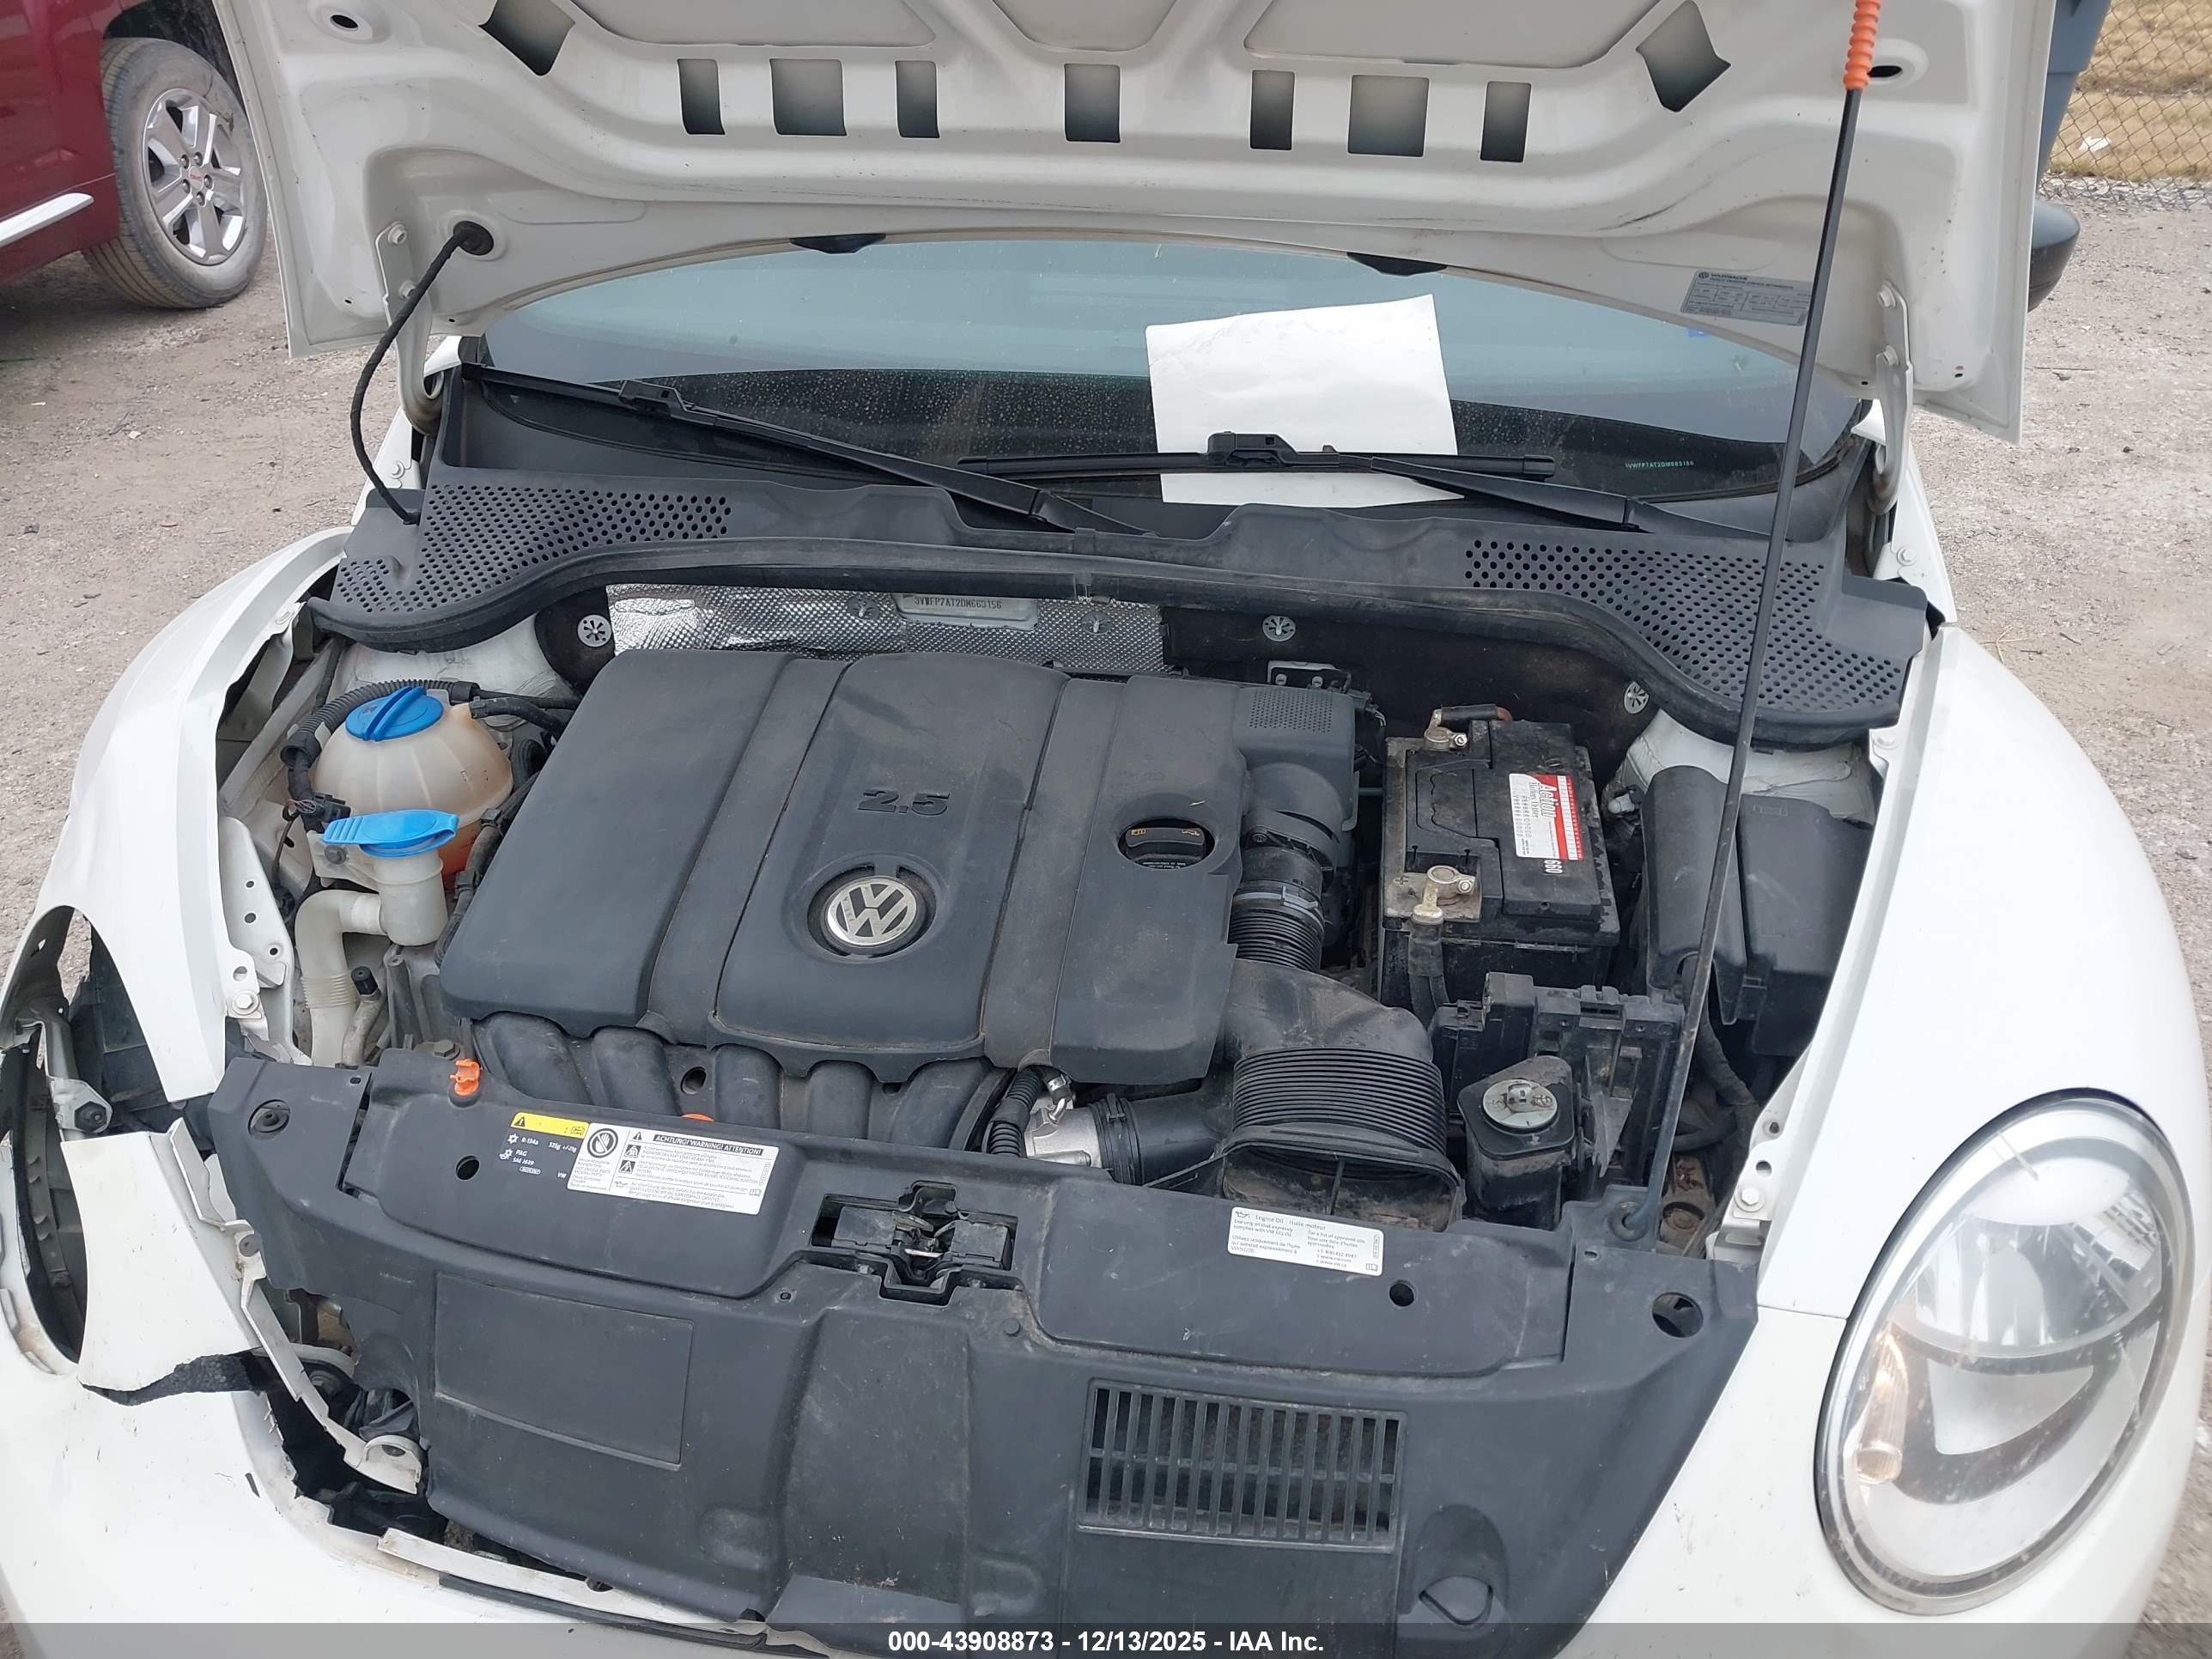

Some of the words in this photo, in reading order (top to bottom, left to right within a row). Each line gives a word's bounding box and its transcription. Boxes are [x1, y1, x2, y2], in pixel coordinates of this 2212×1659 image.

[857, 788, 951, 816] 2.5
[1539, 782, 1559, 818] Action
[1544, 860, 1563, 874] 660
[655, 1134, 688, 1146] ACHTUNG!
[690, 1139, 724, 1152] WARNING!
[724, 1145, 762, 1156] ATTENTION!
